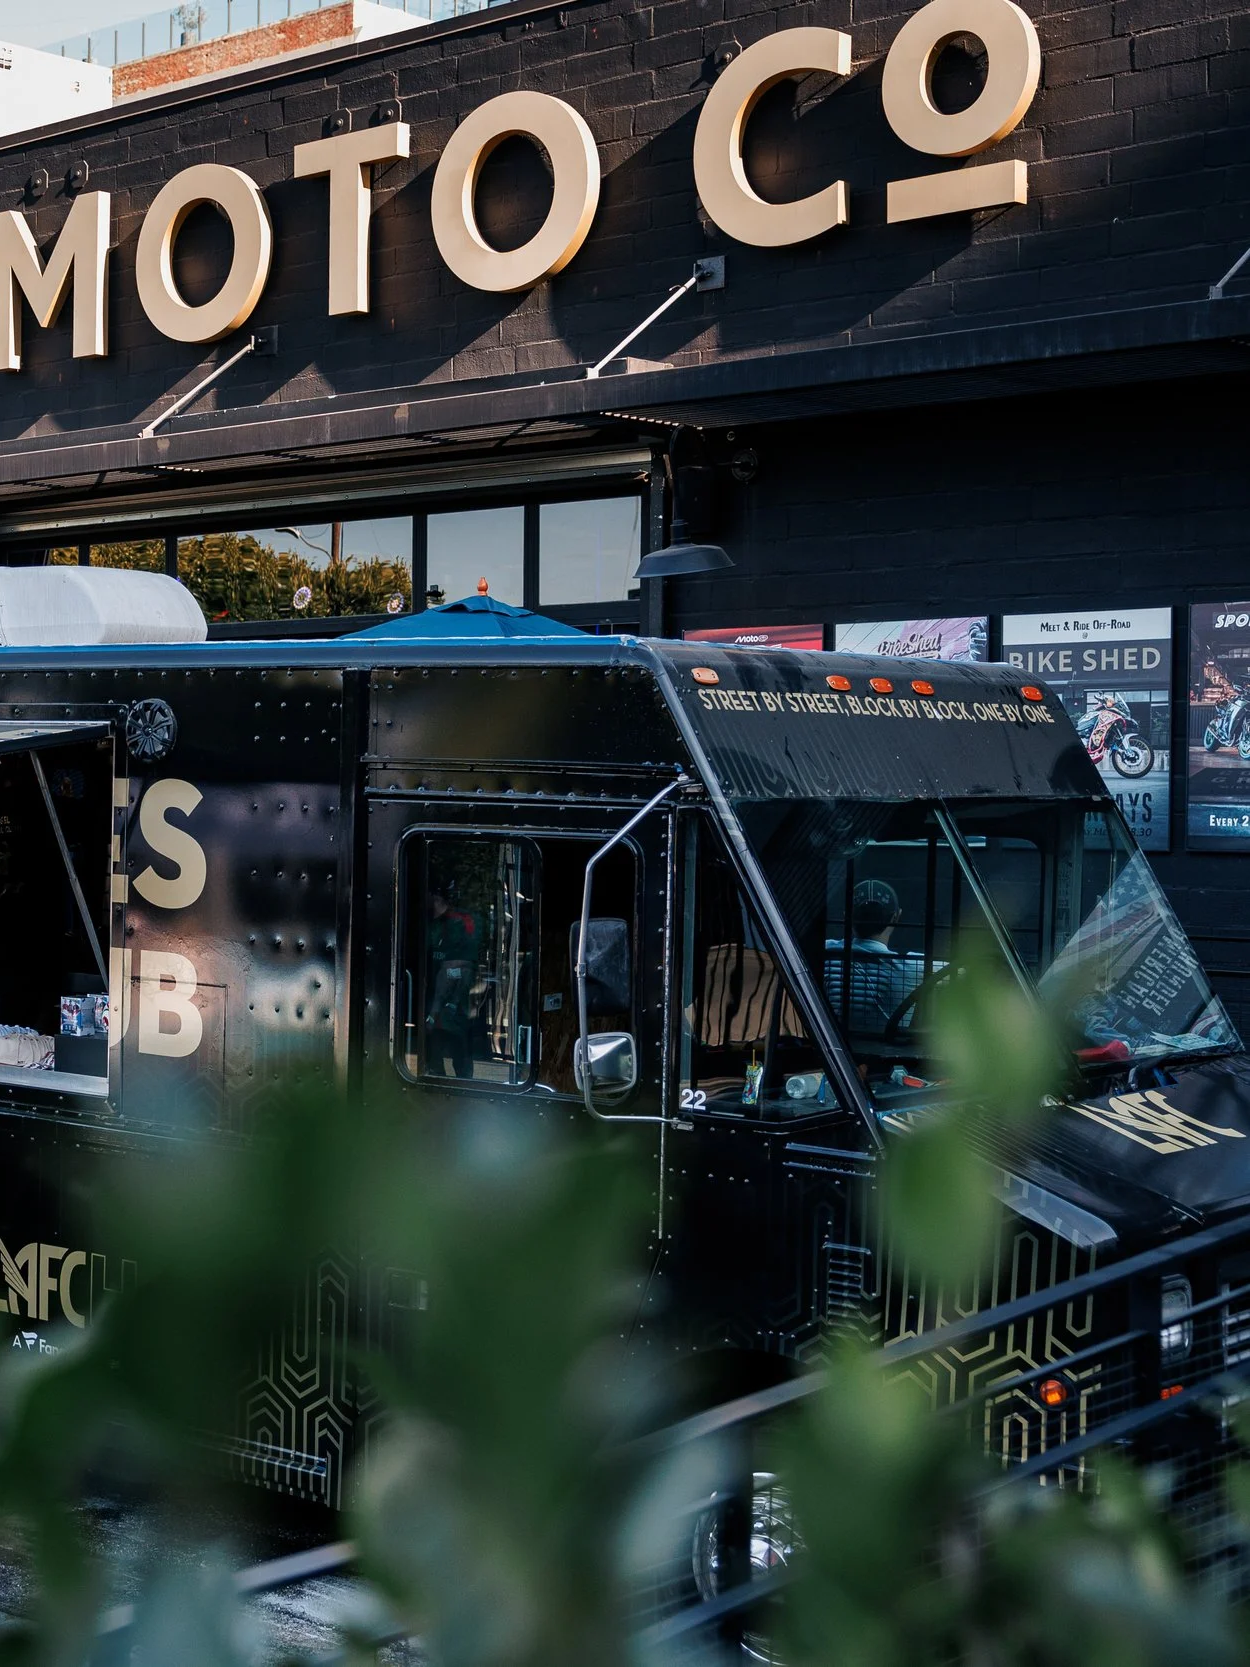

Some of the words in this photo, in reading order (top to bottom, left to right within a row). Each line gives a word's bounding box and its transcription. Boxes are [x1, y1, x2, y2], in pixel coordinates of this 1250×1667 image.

[1215, 612, 1250, 629] SPO
[1009, 650, 1073, 673] BIKE
[1082, 647, 1161, 672] SHED
[697, 689, 762, 711] STREET
[760, 691, 784, 712] BY
[784, 692, 849, 717] STREET,
[849, 695, 903, 717] BLOCK
[899, 698, 922, 719] BY
[973, 702, 1007, 722] ONE
[1002, 704, 1024, 722] BY
[1022, 705, 1055, 723] ONE
[680, 1088, 707, 1111] 22
